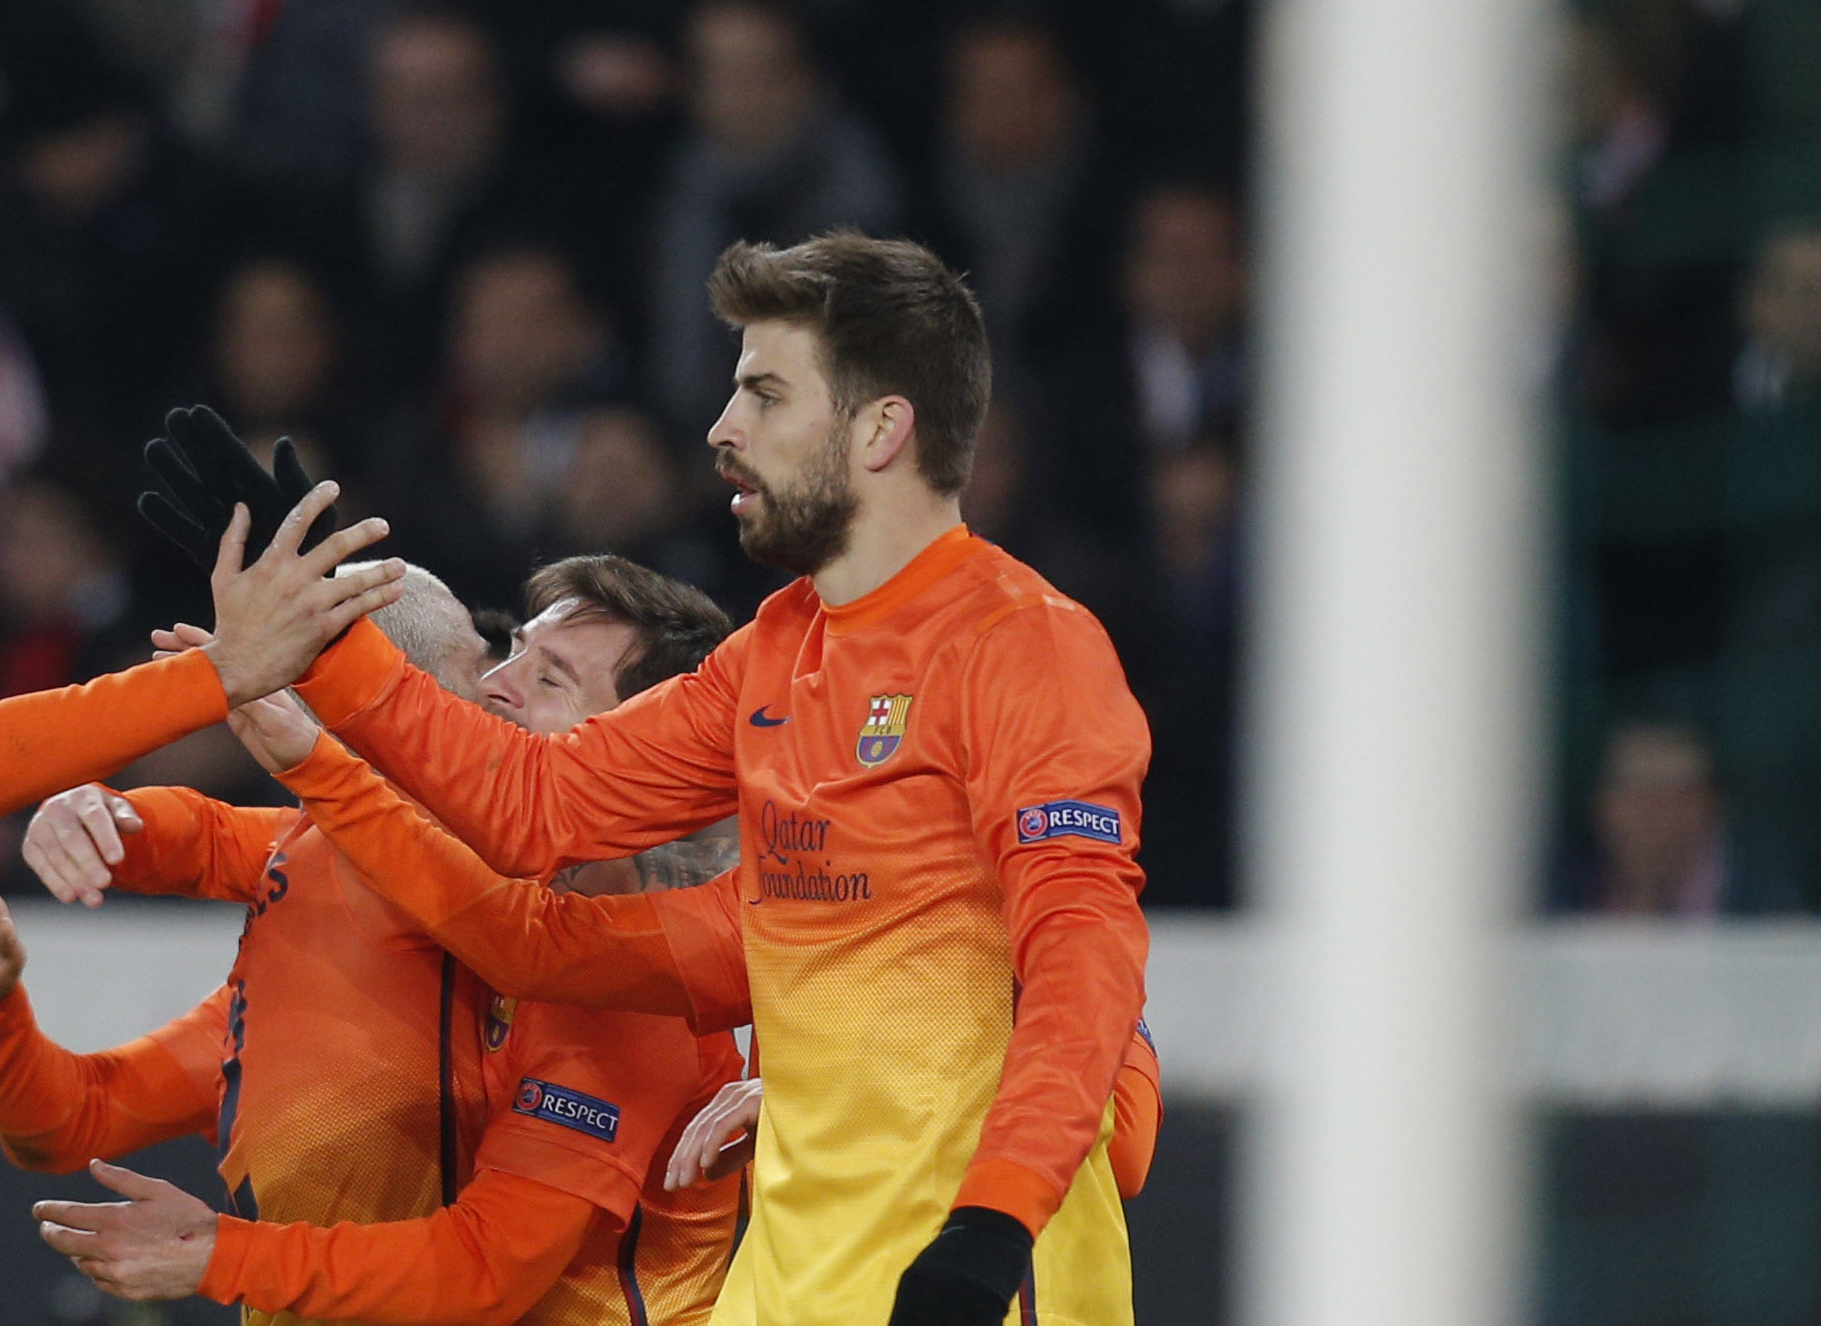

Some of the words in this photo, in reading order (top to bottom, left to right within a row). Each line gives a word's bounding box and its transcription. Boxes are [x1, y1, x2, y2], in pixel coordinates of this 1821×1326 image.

[762, 799, 831, 866] Qatar
[1049, 809, 1119, 834] RESPECT
[542, 1094, 619, 1132] RESPECT
